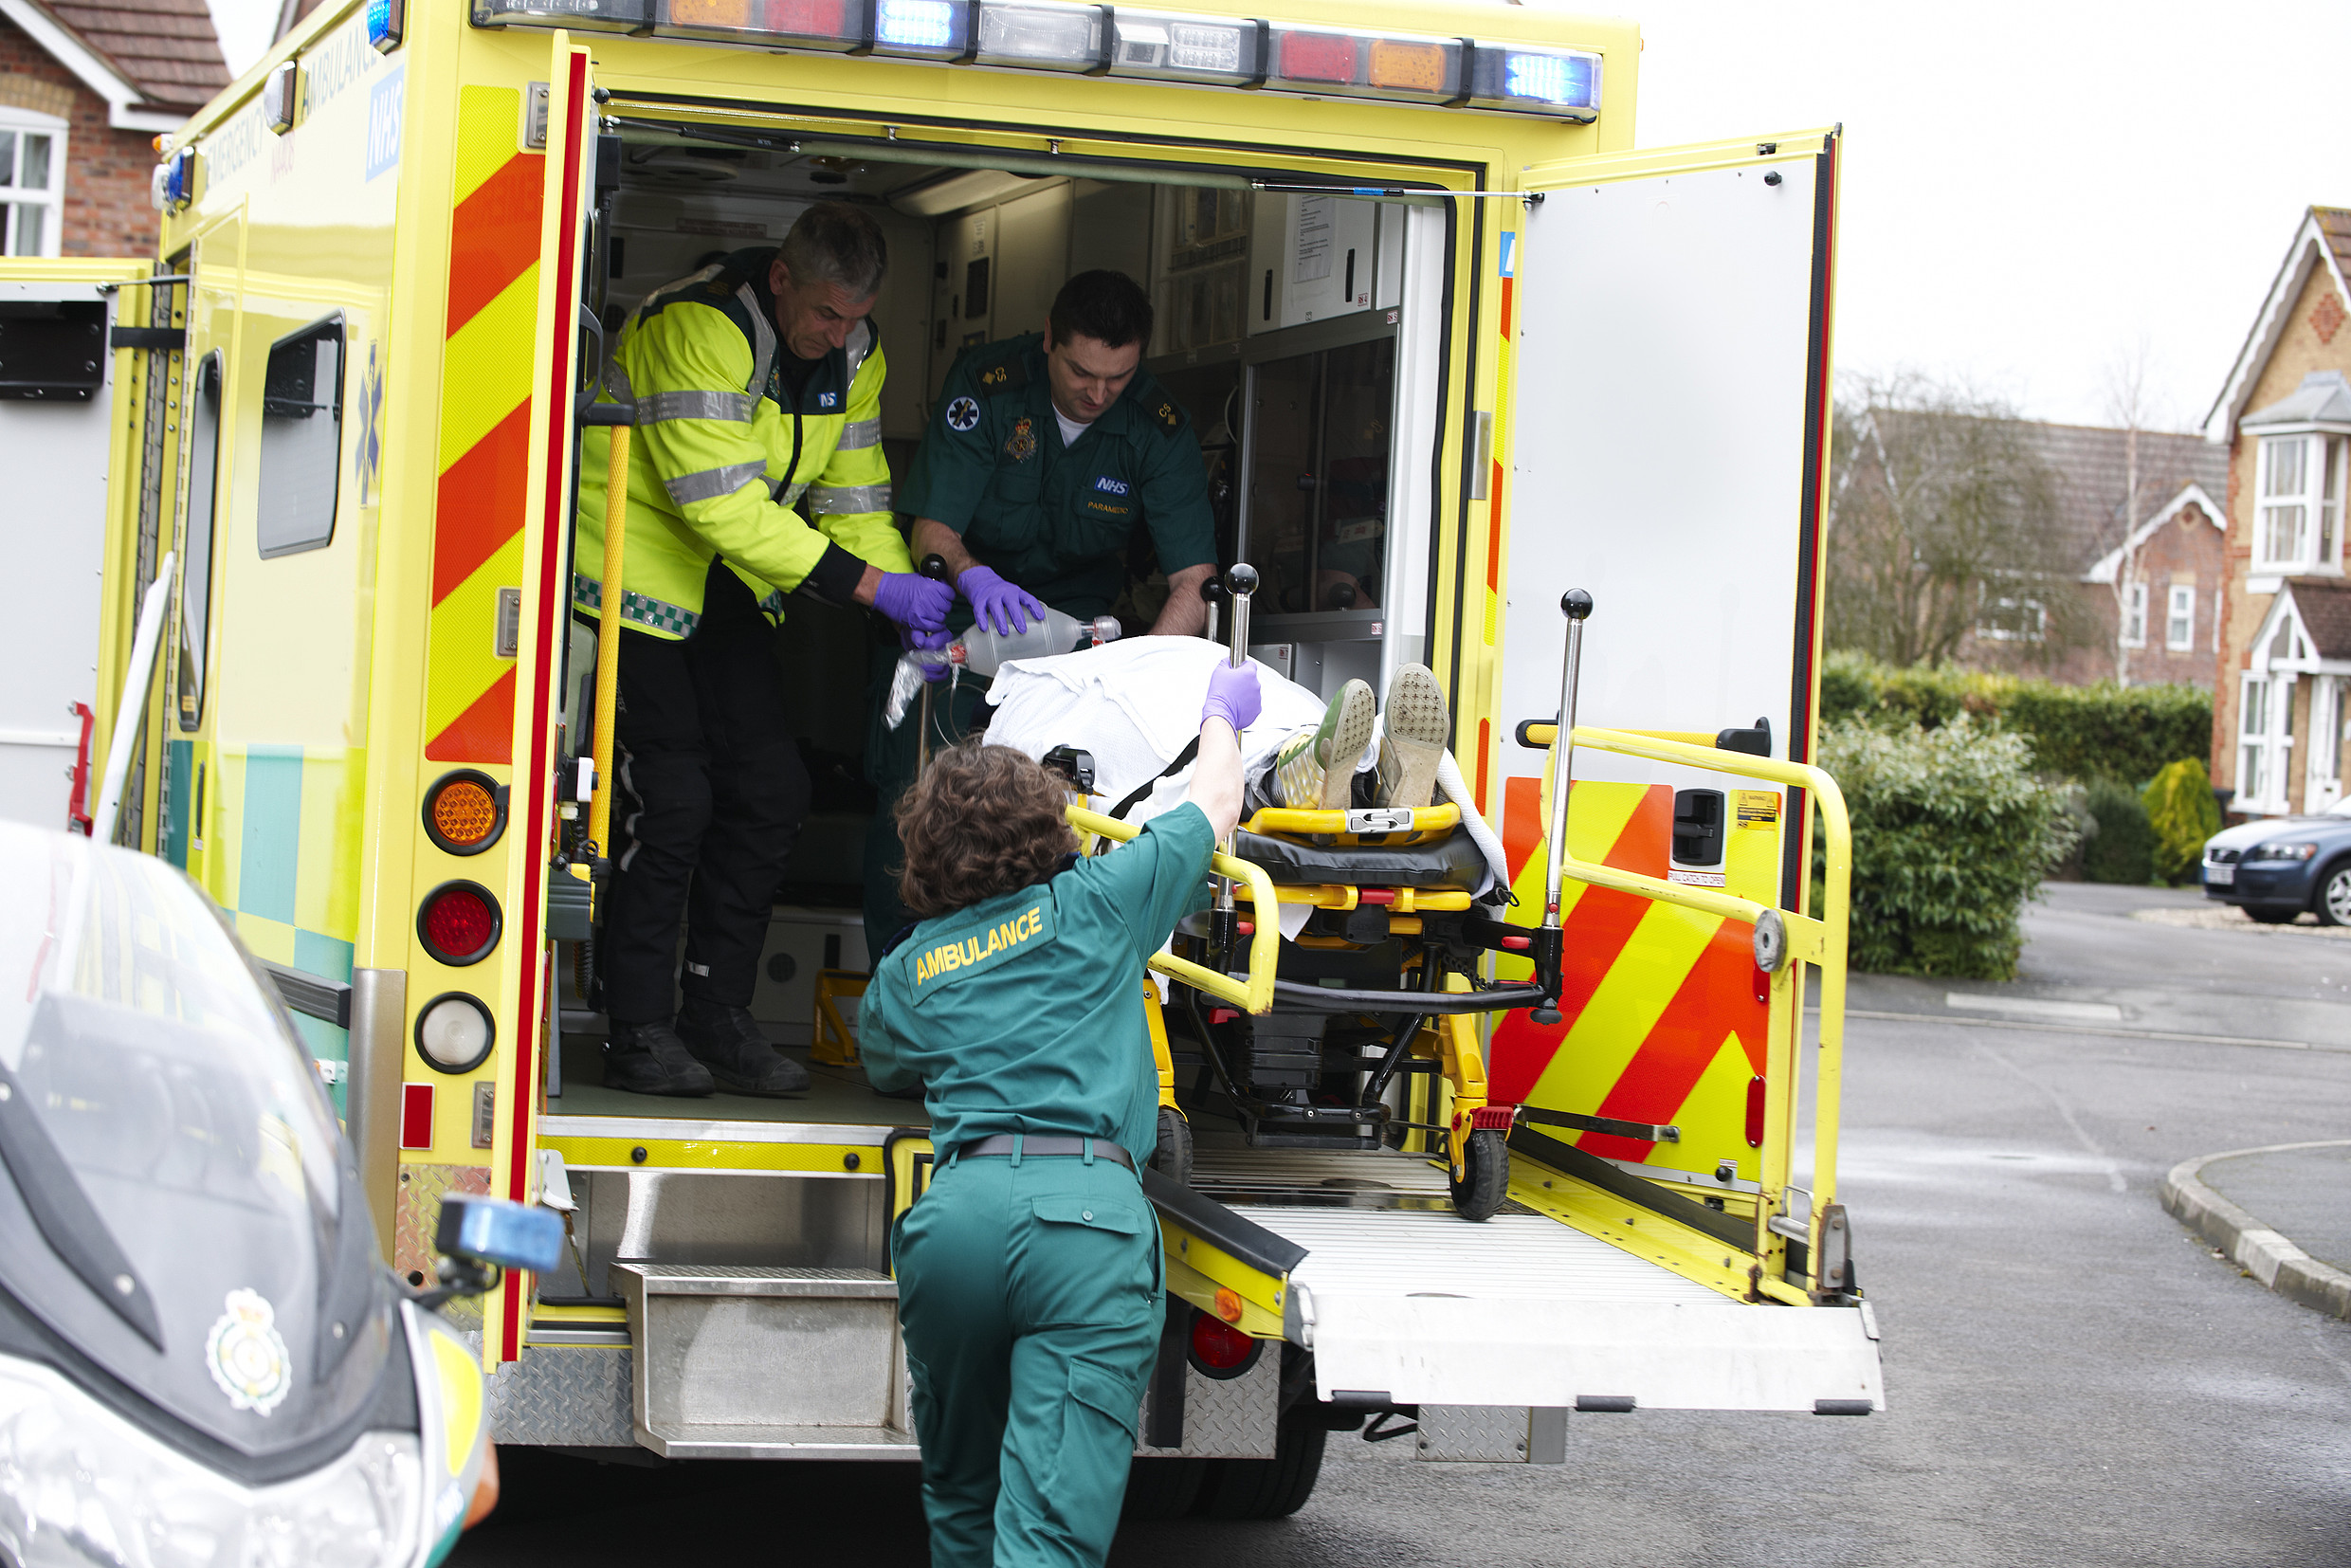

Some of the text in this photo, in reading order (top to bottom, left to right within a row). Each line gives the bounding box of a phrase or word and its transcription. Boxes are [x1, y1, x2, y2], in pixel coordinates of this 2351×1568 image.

[368, 80, 403, 171] NHS
[1158, 402, 1172, 418] CS
[1097, 477, 1128, 495] NHS
[916, 905, 1043, 986] AMBULANCE
